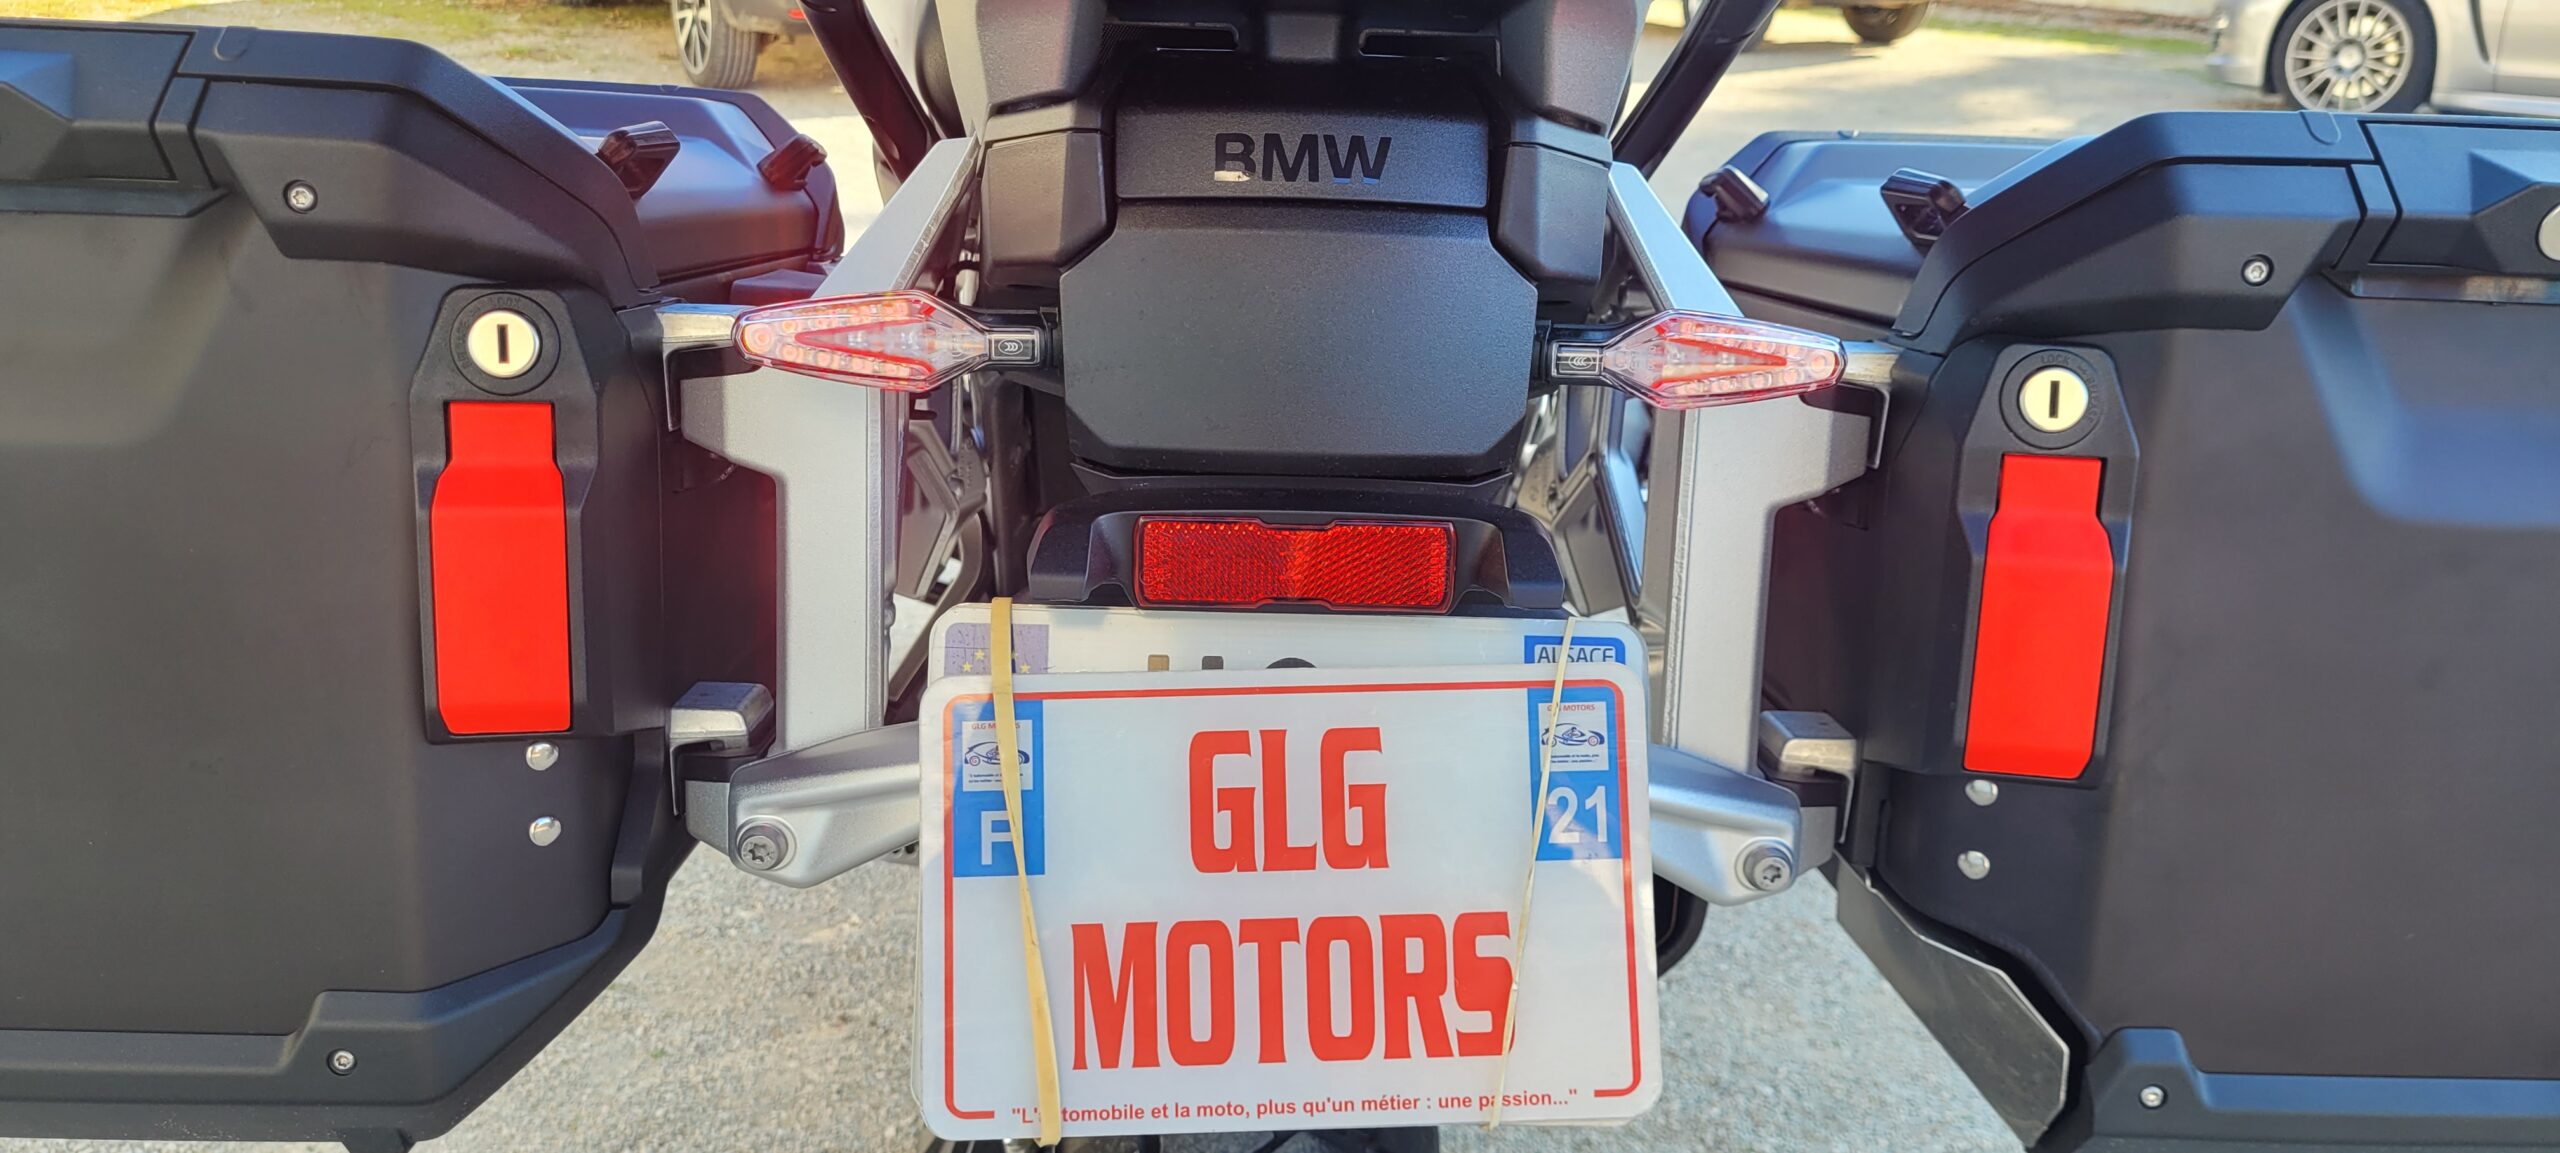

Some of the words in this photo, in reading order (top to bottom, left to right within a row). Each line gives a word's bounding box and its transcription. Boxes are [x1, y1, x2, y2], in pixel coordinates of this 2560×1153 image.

[1214, 132, 1393, 184] BMW
[1562, 704, 1596, 712] MOTORS
[1188, 727, 1390, 873] GLG
[1547, 785, 1608, 844] 21
[981, 810, 1014, 865] F
[1071, 911, 1516, 1070] MOTORS
[1012, 1104, 1145, 1123] "L'tomobile
[1151, 1105, 1169, 1119] et
[1175, 1102, 1190, 1118] la
[1196, 1101, 1250, 1119] moto,
[1256, 1098, 1296, 1119] plus
[1302, 1097, 1354, 1117] qu'un
[1361, 1094, 1420, 1112] métier
[1426, 1096, 1432, 1109] :
[1438, 1094, 1472, 1109] une
